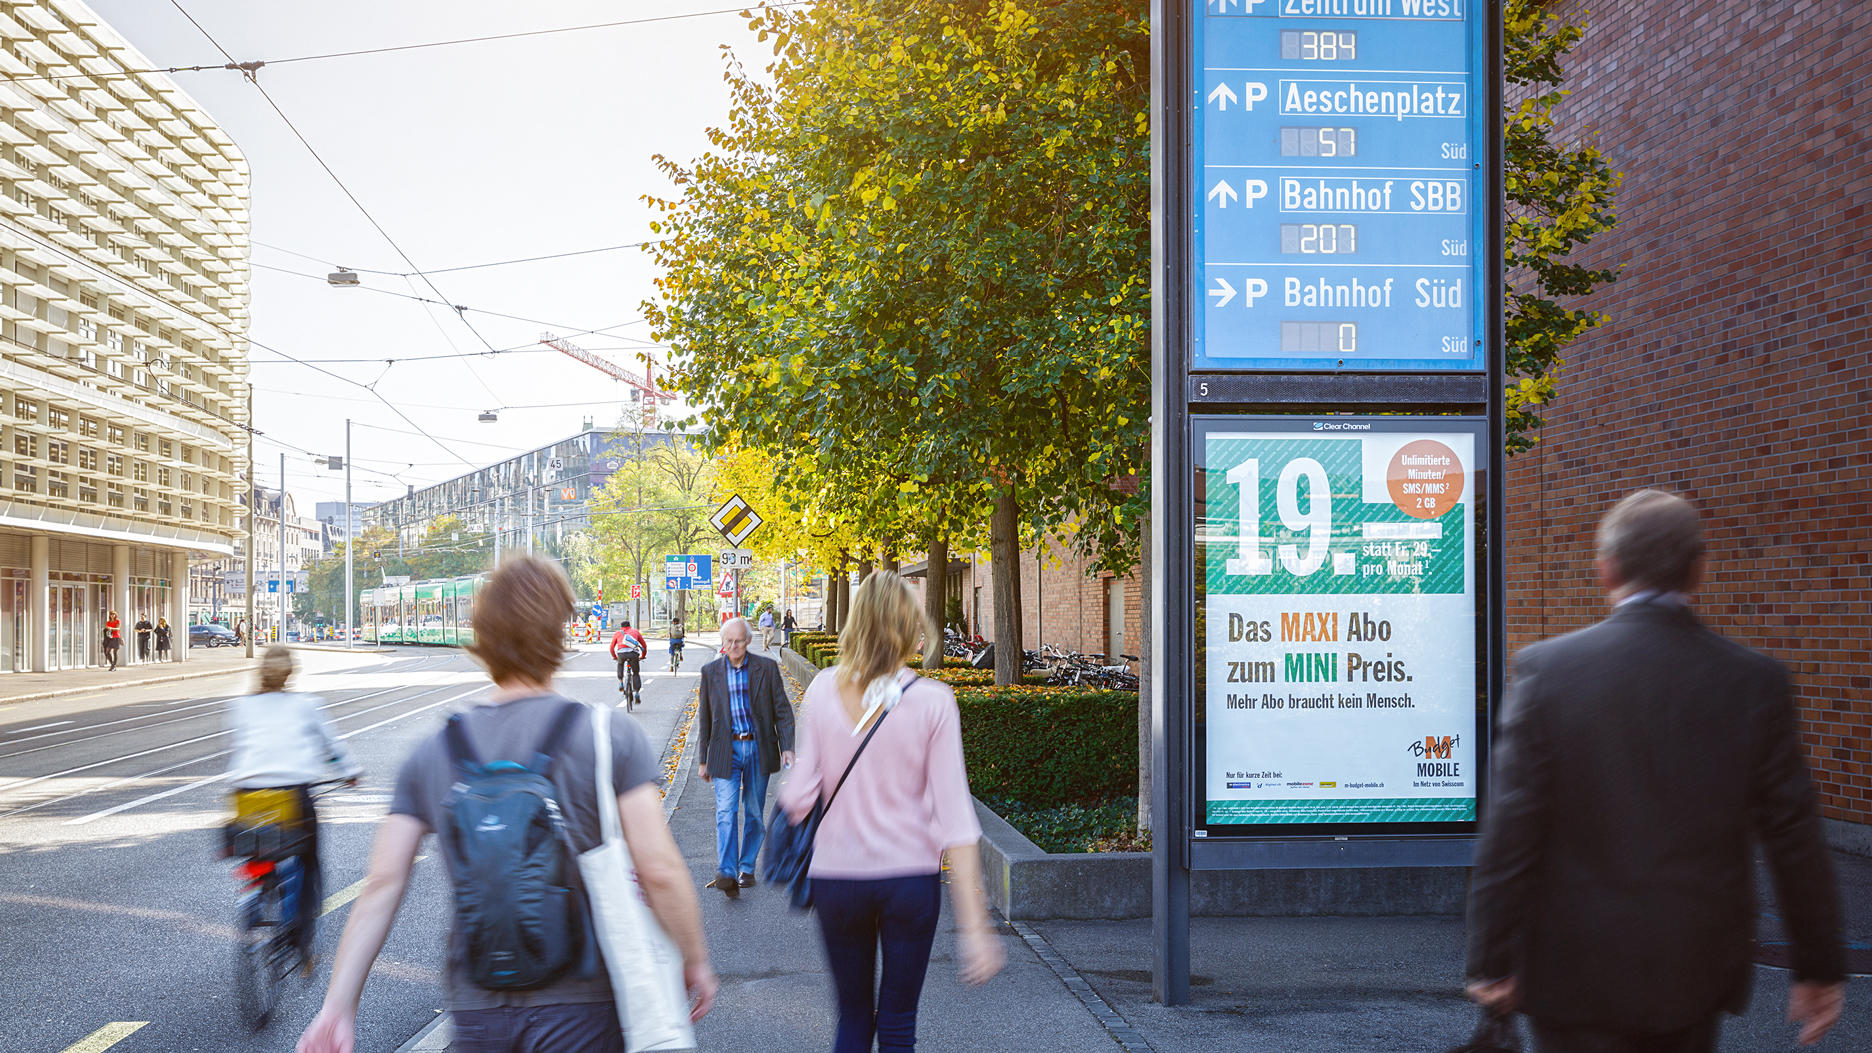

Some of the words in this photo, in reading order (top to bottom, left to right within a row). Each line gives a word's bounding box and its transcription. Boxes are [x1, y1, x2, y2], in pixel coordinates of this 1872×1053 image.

[1303, 32, 1356, 60] 384
[1246, 82, 1268, 111] P
[1285, 82, 1461, 121] Aeschenplatz
[1319, 128, 1355, 157] 57
[1441, 142, 1467, 160] Süd
[1246, 179, 1268, 209] P
[1285, 180, 1393, 210] Bahnhof
[1410, 181, 1462, 212] SBB
[1301, 225, 1355, 254] 207
[1441, 238, 1467, 257] Süd
[1246, 279, 1268, 308] P
[1285, 277, 1393, 308] Bahnhof
[1415, 277, 1462, 309] Süd
[1339, 323, 1356, 352] 0
[1442, 335, 1468, 354] Süd
[1200, 383, 1208, 397] 5
[1323, 421, 1342, 431] Clear
[1342, 421, 1371, 431] Channel
[550, 459, 562, 469] 45
[1401, 454, 1451, 466] Unlimitierte
[1407, 469, 1447, 480] Minuten/
[1416, 497, 1422, 509] 2
[1424, 497, 1436, 509] GB
[1362, 541, 1392, 557] statt
[1395, 541, 1410, 557] Fr.
[1362, 564, 1384, 578] pro
[1228, 612, 1272, 643] Das
[1280, 612, 1339, 642] MAXI
[1346, 611, 1392, 642] Abo
[1226, 660, 1276, 683] zum
[1284, 652, 1338, 683] MINI
[1347, 652, 1413, 683] Preis.
[1226, 693, 1258, 710] Mehr
[1261, 693, 1284, 709] Abo
[1288, 693, 1335, 709] braucht
[1338, 693, 1363, 709] kein
[1366, 692, 1416, 709] Mensch.
[1407, 734, 1461, 759] Budget
[1226, 771, 1235, 779] Nur
[1236, 771, 1245, 779] für
[1245, 771, 1261, 779] kurze
[1261, 770, 1272, 779] Zeit
[1417, 762, 1460, 778] MOBILE
